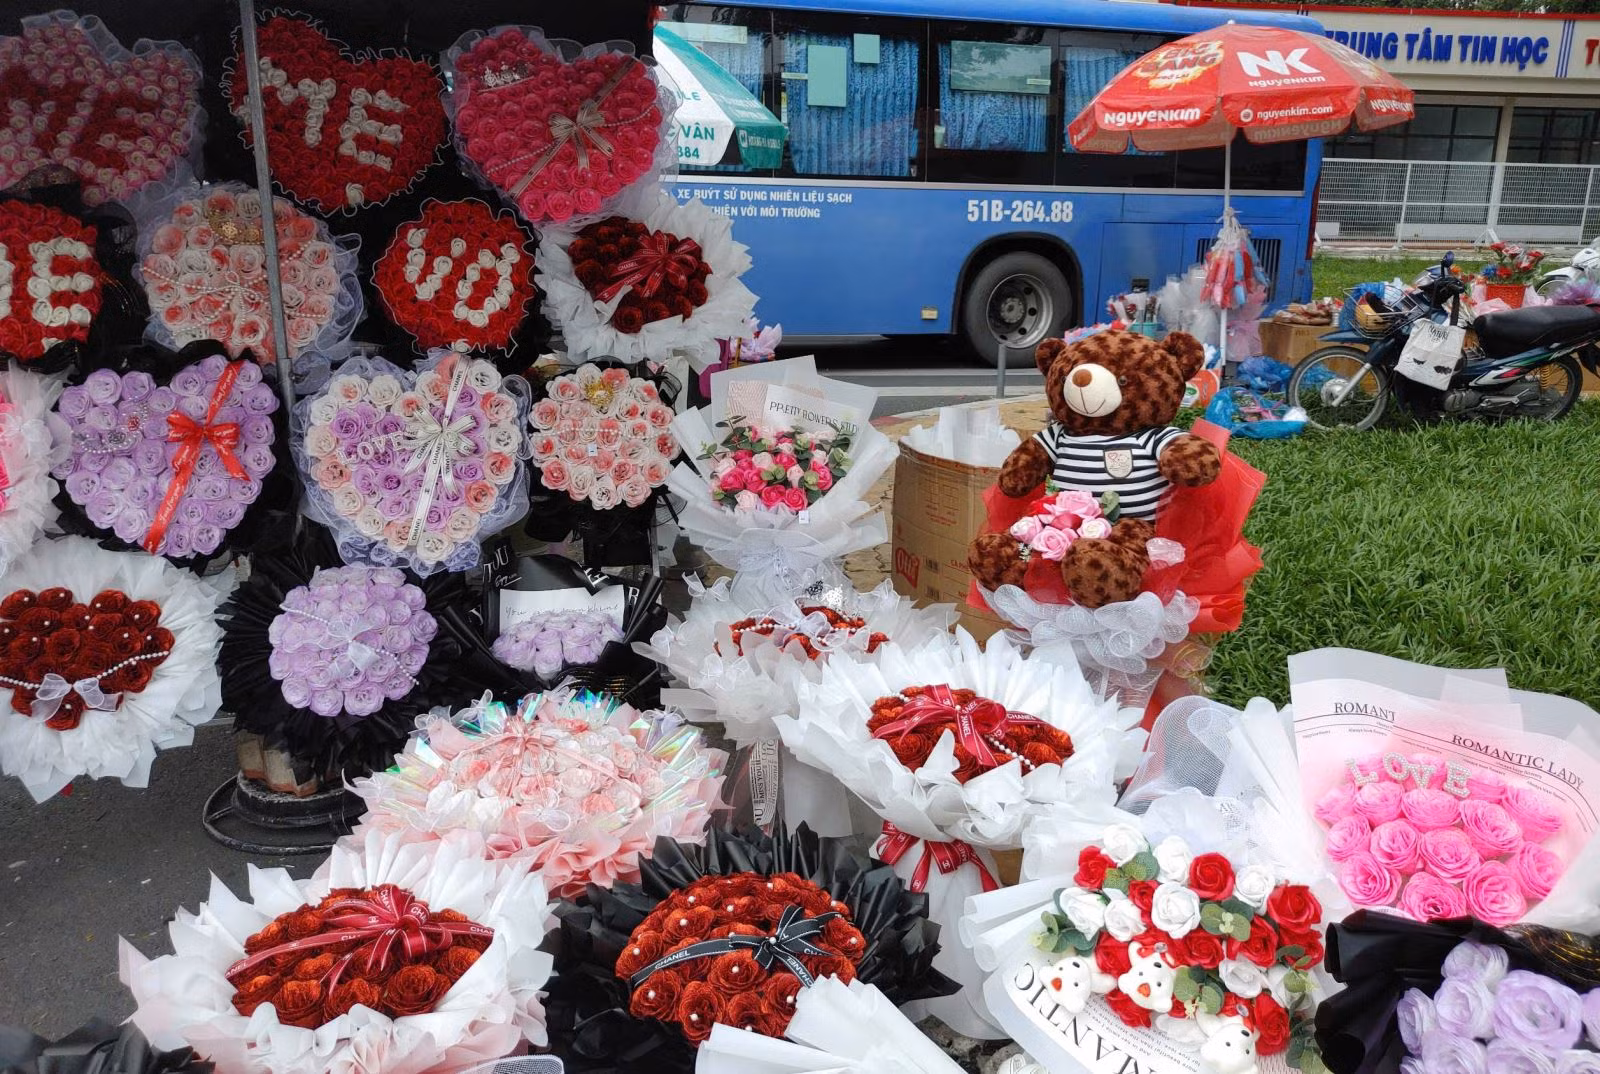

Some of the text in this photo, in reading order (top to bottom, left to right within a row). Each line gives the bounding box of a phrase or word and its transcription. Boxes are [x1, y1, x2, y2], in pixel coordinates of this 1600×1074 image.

[1405, 27, 1452, 62] TÂM
[1458, 35, 1497, 64] TIN
[1500, 36, 1549, 71] HỌC
[1585, 38, 1600, 66] T
[1237, 48, 1321, 77] NK
[1257, 104, 1333, 120] nguyenkim.com
[681, 122, 715, 140] VÂN
[677, 189, 690, 199] XE
[740, 190, 767, 201] DỤNG
[770, 189, 800, 201] NHIÊN
[802, 190, 824, 204] LIỆU
[826, 193, 852, 204] SẠCH
[760, 205, 779, 217] MÔI
[967, 199, 1073, 222] 51B-264.88
[1451, 734, 1545, 769] ROMANTIC
[1548, 762, 1584, 790] LADY
[1345, 752, 1472, 799] LOVE
[655, 950, 691, 969] CHANEL
